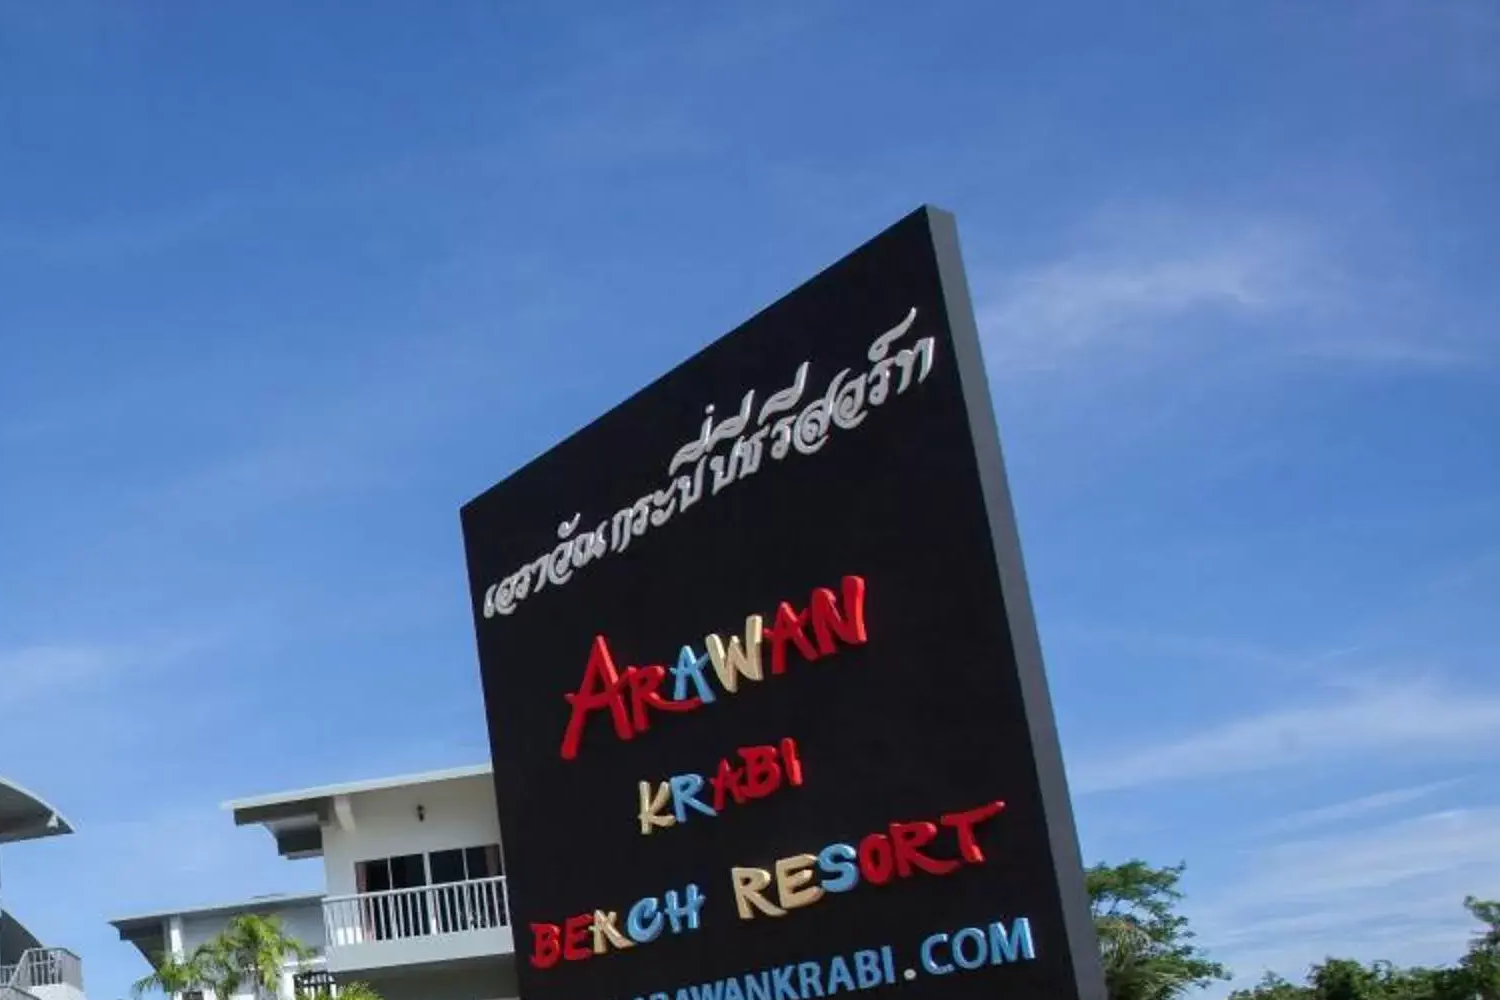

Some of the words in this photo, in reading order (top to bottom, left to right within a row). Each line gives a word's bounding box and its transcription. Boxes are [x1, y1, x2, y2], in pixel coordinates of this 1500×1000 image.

[561, 576, 866, 760] ARAWAN
[638, 738, 803, 834] KRABI
[732, 801, 1005, 919] RESORT
